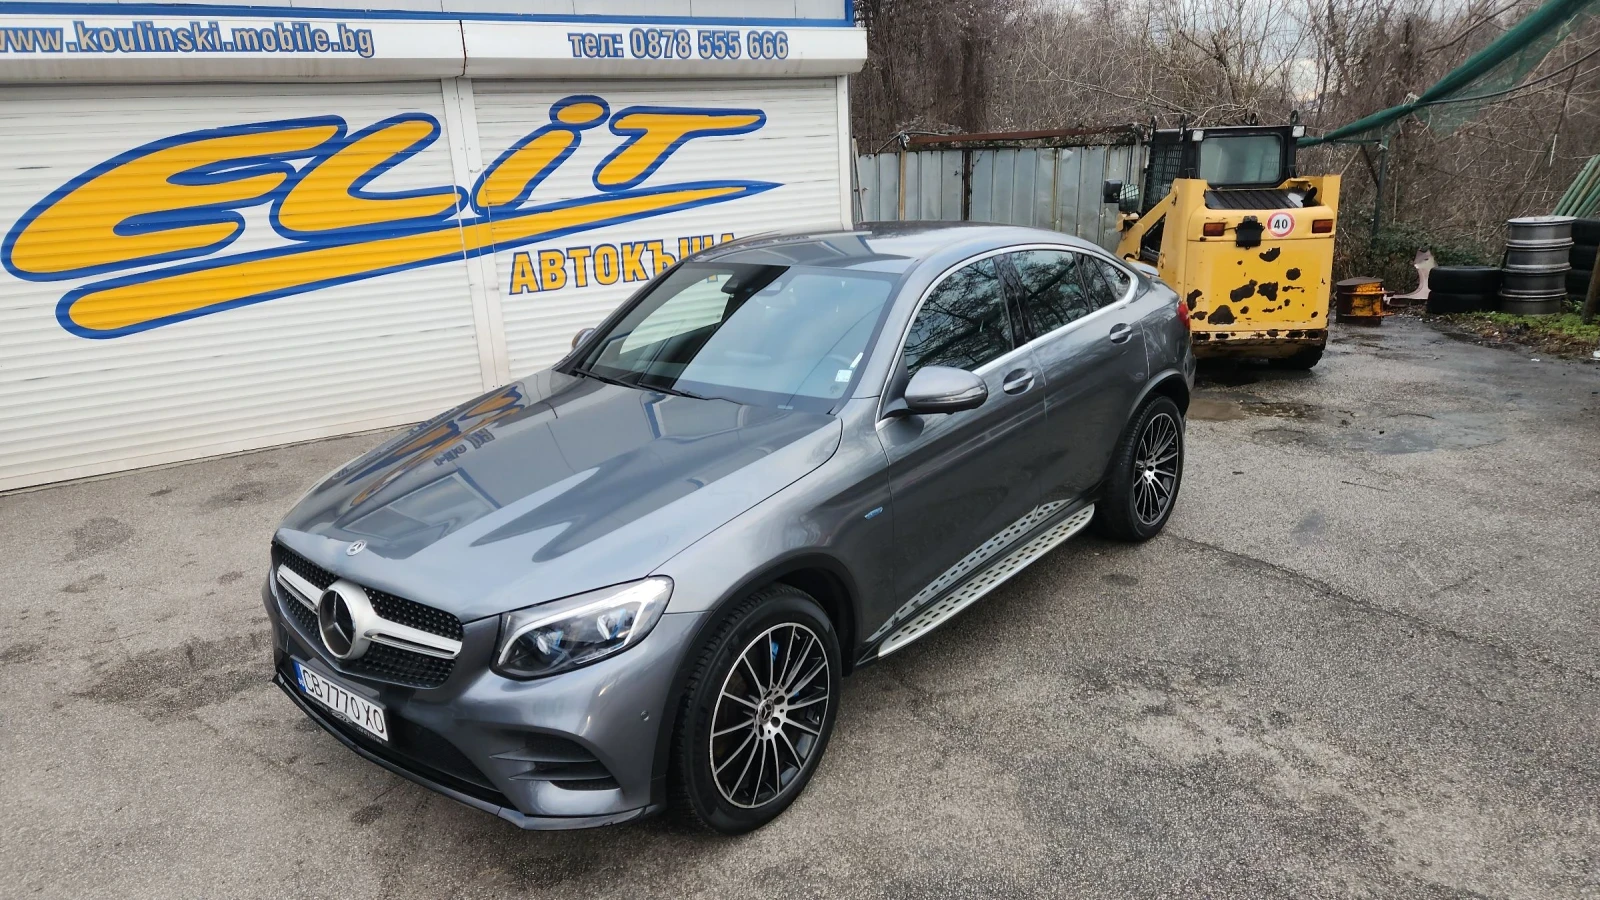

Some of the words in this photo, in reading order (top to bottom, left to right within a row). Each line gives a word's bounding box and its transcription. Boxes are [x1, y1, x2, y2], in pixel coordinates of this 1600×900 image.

[0, 20, 375, 58] ww.koulinski.mobile.bg
[629, 27, 692, 59] 0878
[697, 29, 742, 59] 555
[747, 30, 789, 60] 666
[1273, 218, 1288, 230] 40
